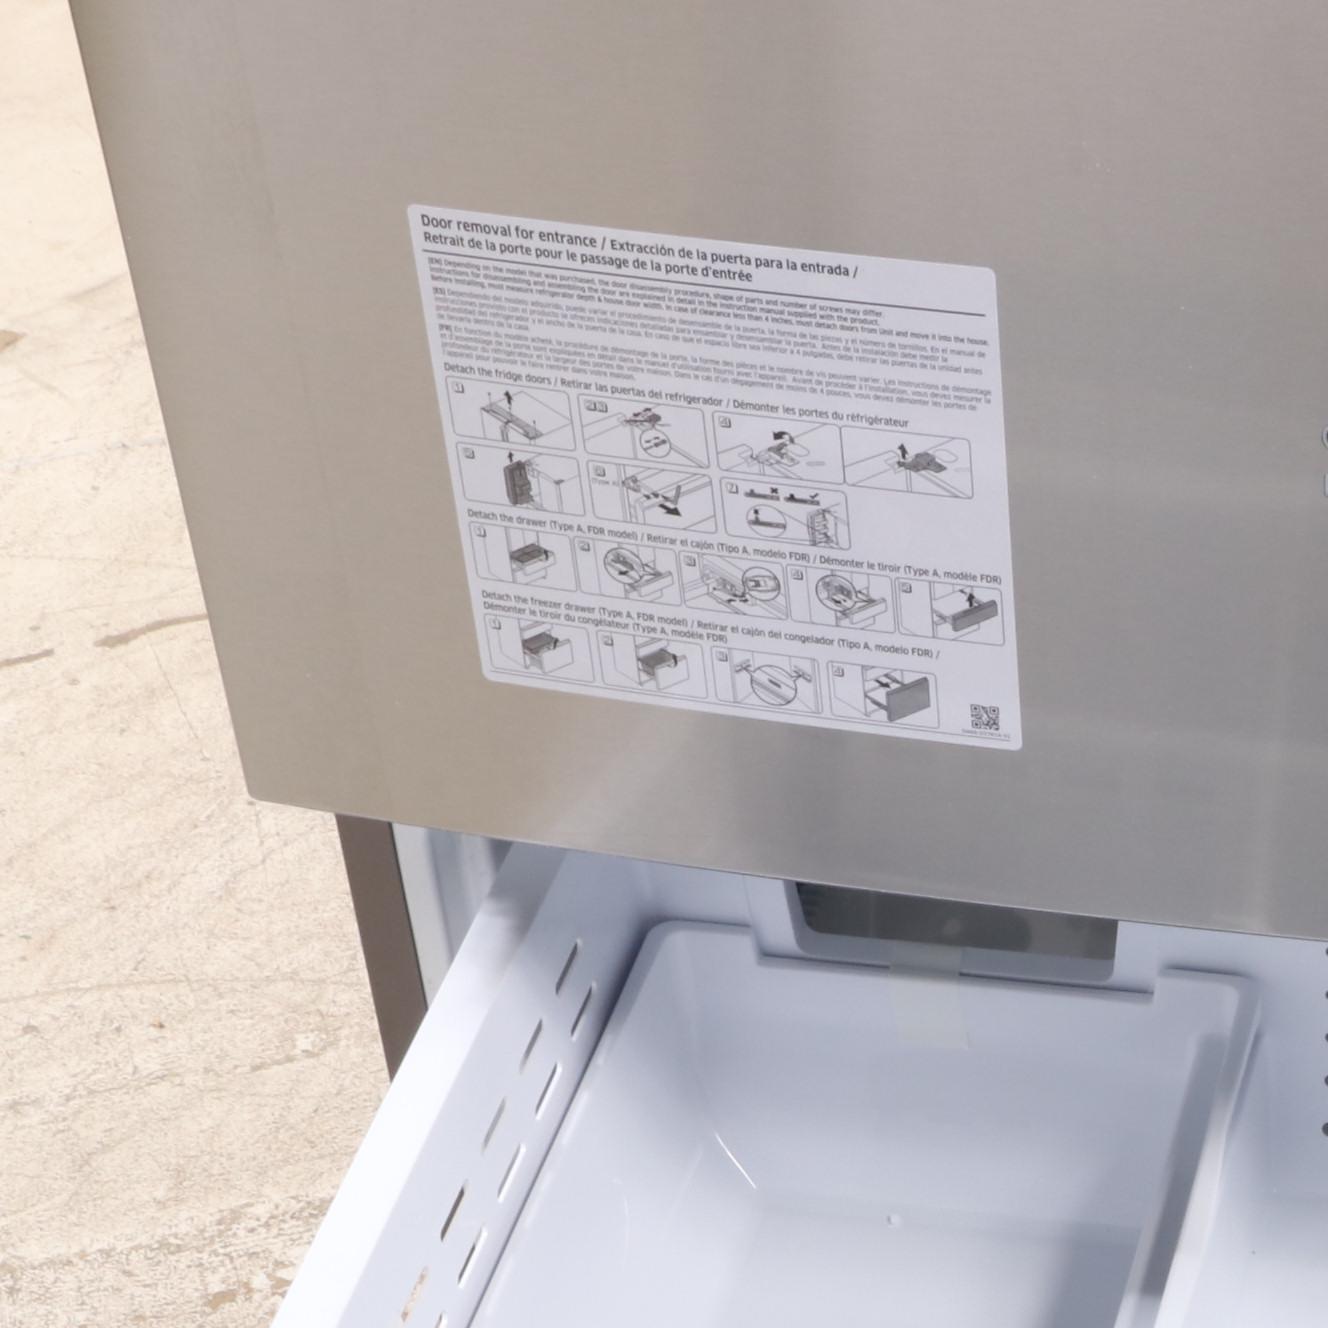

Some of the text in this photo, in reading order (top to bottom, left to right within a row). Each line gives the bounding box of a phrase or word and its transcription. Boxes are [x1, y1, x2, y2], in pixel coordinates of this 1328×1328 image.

[421, 213, 454, 230] Door
[456, 221, 512, 237] removal
[514, 224, 536, 240] for
[538, 229, 598, 247] entrance
[609, 236, 676, 256] Extracción
[677, 243, 694, 258] de
[696, 246, 708, 260] la
[710, 251, 752, 265] puerta
[754, 256, 784, 270] para
[785, 256, 798, 270] la
[800, 259, 850, 276] entrada
[423, 231, 466, 247] Retrait
[467, 237, 484, 249] de
[485, 239, 497, 251] la
[499, 243, 533, 255] porte
[534, 247, 564, 260] pour
[565, 249, 578, 261] le
[580, 253, 630, 269] passage
[631, 257, 648, 269] de
[650, 259, 662, 270] la
[664, 263, 699, 275] porte
[443, 362, 476, 375] Detach
[477, 366, 494, 377] the
[494, 368, 524, 383] fridge
[524, 372, 552, 385] doors
[559, 376, 593, 390] Retirar
[594, 380, 609, 391] las
[609, 385, 646, 396] puertas
[647, 387, 663, 398] del
[664, 390, 724, 405] refrigerador
[732, 397, 780, 412] Démonter
[781, 402, 796, 413] les
[797, 406, 830, 417] portes
[831, 408, 844, 419] du
[845, 410, 909, 426] réfrigérateur
